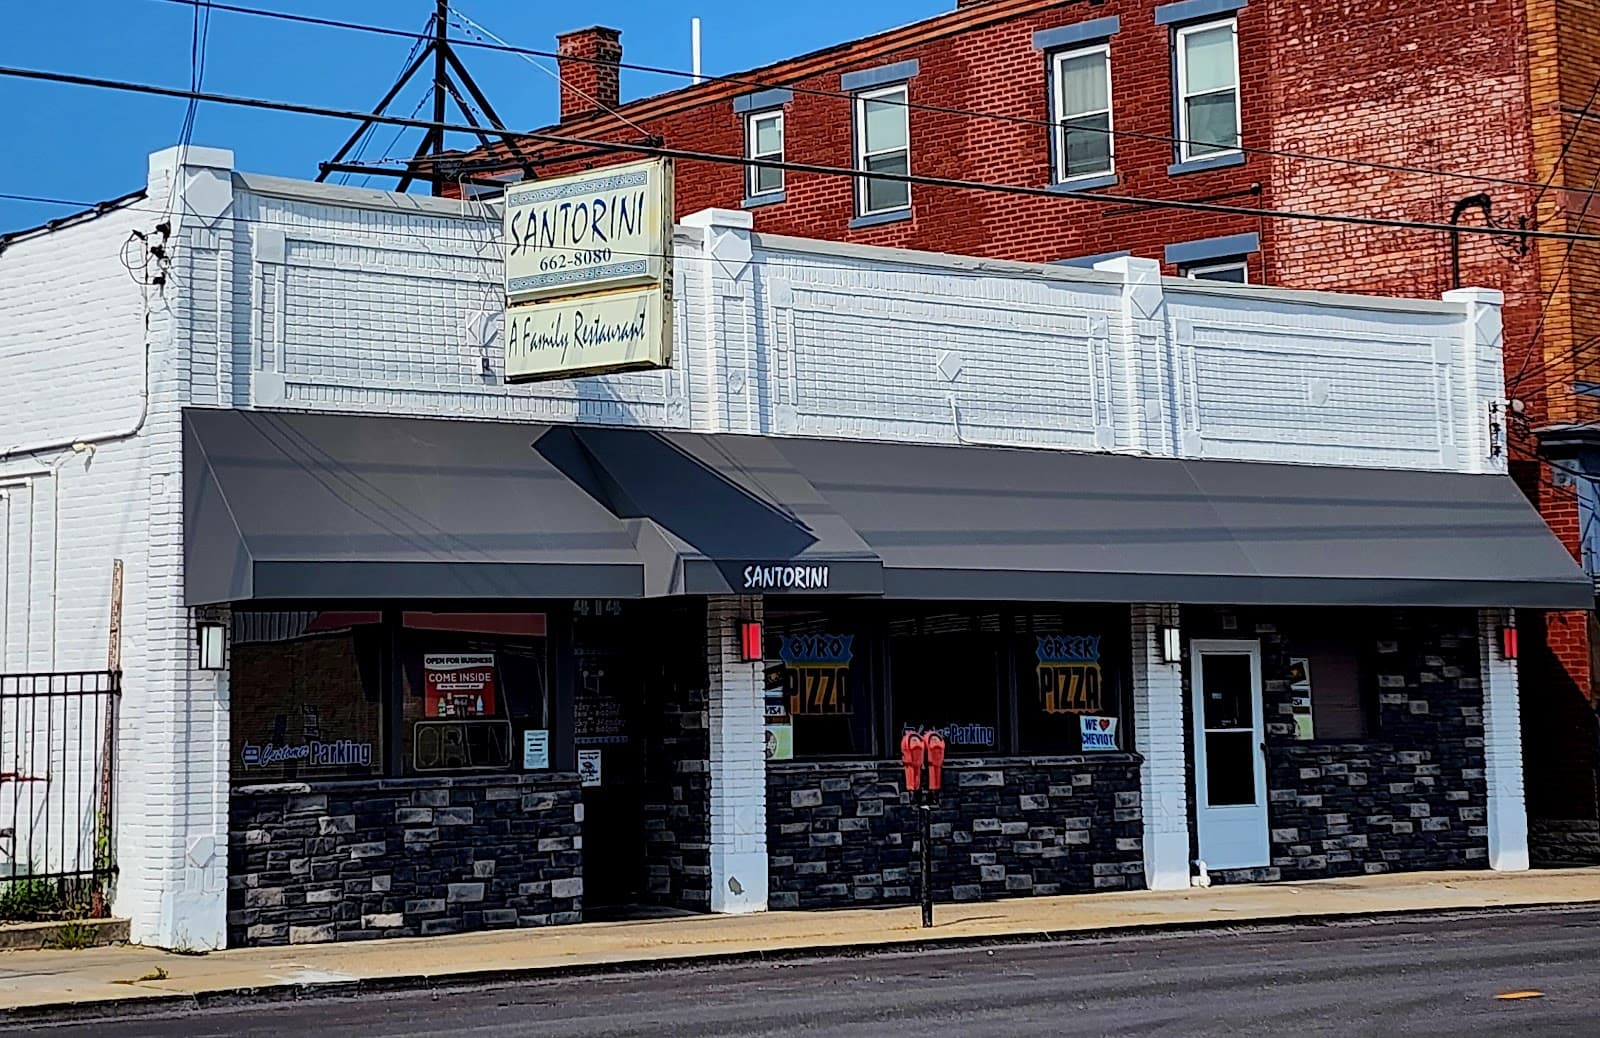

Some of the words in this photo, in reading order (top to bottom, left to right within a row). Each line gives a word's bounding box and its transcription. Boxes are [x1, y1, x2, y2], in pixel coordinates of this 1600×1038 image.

[510, 191, 644, 256] SANTORINI
[539, 248, 612, 272] 662-8080
[508, 316, 518, 358] A
[522, 311, 569, 365] Family
[573, 306, 647, 349] Restaurant
[744, 565, 828, 588] SANTORINI
[790, 637, 844, 659] GYRO
[1042, 637, 1094, 659] GREEK
[426, 656, 445, 665] OPEN
[446, 656, 460, 665] FOR
[461, 656, 493, 664] BUSINESS
[428, 673, 457, 683] COME
[459, 672, 492, 682] INSIDE
[1039, 666, 1102, 711] PIZZA
[787, 667, 852, 715] PIZZA
[765, 706, 781, 715] VISA
[950, 723, 994, 746] Parking
[1084, 718, 1098, 730] WE
[1081, 733, 1114, 746] CHEVIOT
[310, 739, 372, 766] Parking
